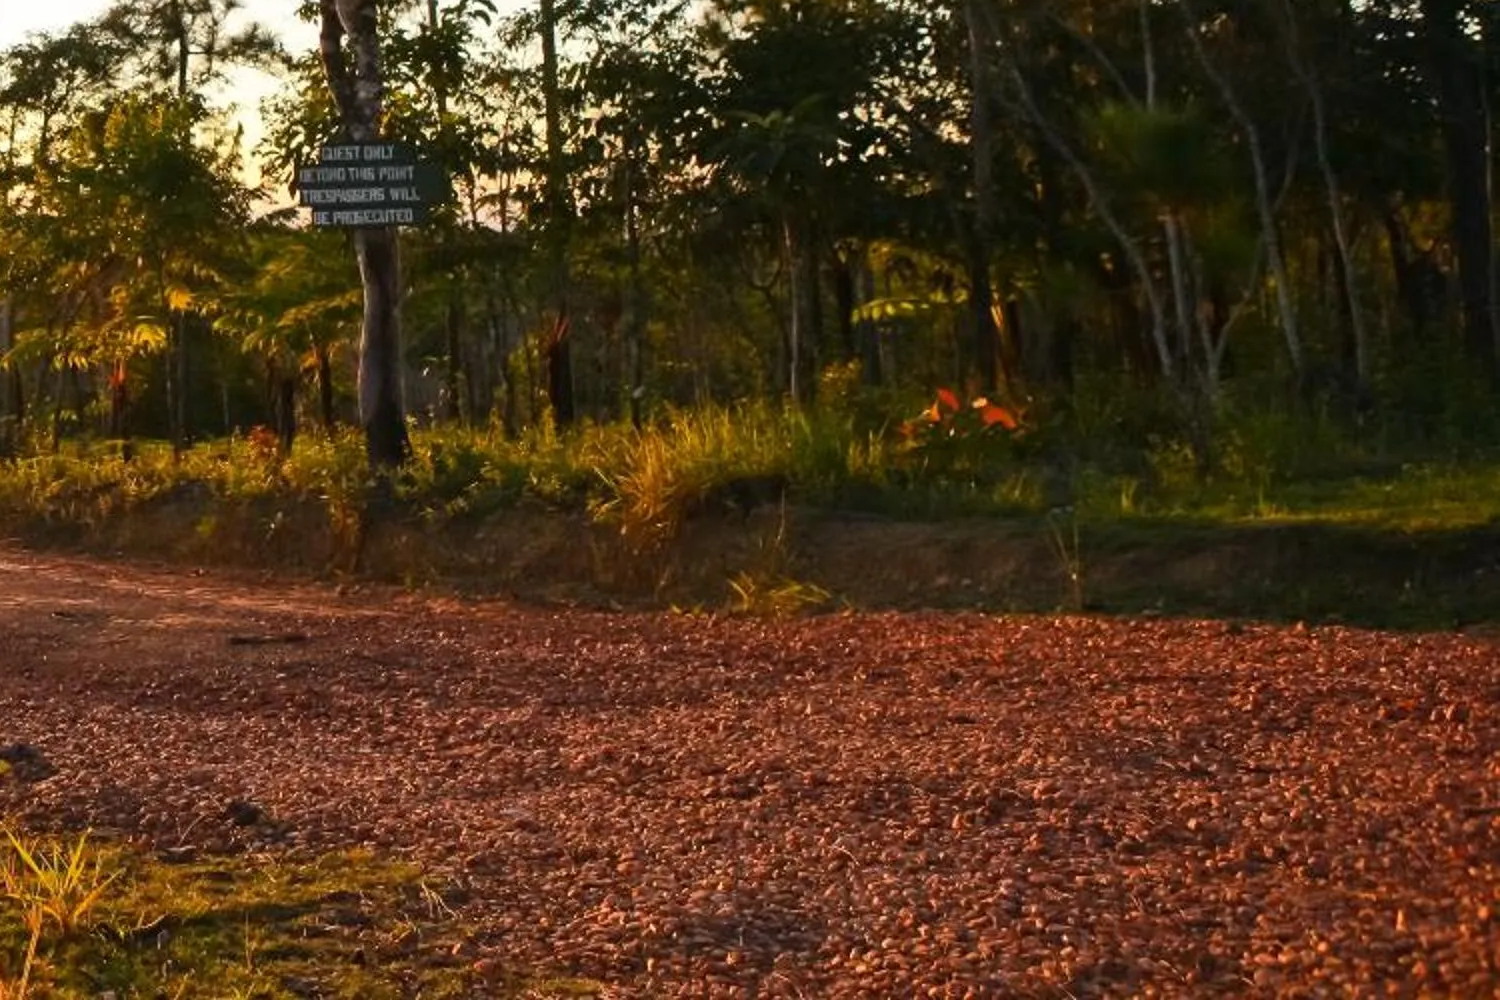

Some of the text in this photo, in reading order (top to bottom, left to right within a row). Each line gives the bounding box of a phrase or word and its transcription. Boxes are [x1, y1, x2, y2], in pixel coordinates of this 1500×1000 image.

[363, 144, 395, 160] ONLY
[347, 167, 376, 181] THIS
[379, 166, 415, 181] POINT
[390, 186, 421, 201] WILL
[313, 211, 332, 225] BE
